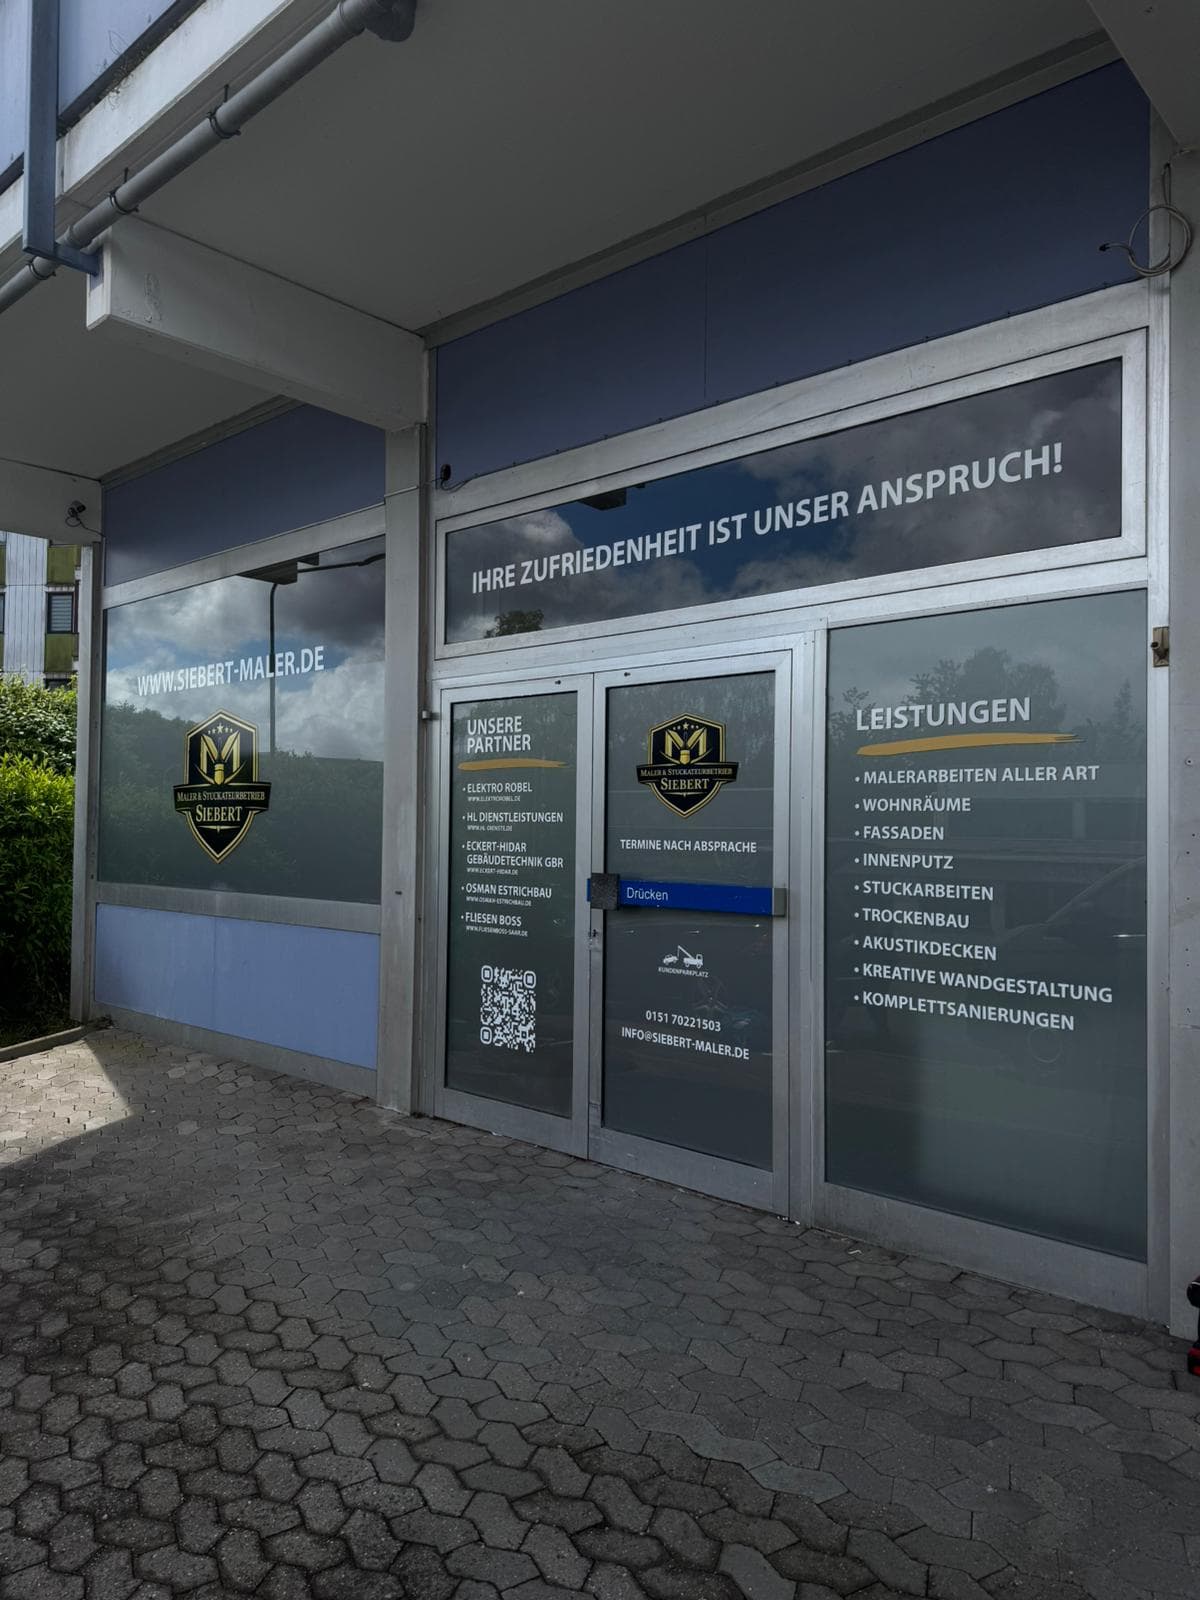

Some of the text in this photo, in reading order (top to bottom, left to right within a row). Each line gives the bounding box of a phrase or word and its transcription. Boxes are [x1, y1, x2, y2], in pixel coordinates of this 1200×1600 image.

[471, 442, 1064, 594] IHRE ZUFRIEDENHEIT IST UNSER ANSPRUCH!
[137, 645, 325, 697] WWW.SIEBERT-MALER.DE
[856, 697, 1032, 732] LEISTUNGEN
[467, 715, 523, 736] UNSERE
[467, 733, 532, 754] PARTNER
[863, 765, 1100, 785] MALERARBEITEN ALLER ART
[467, 782, 533, 794] ELEKTRO ROBEL
[862, 795, 972, 813] WOHNRÄUME
[466, 811, 564, 823] HL DIENSTLEISTUNGEN
[863, 825, 945, 841] FASSADEN
[466, 841, 527, 853] ECKERT-HIDAR
[620, 839, 757, 853] TERMINE NACH ABSPRACHE
[466, 853, 564, 868] GEBÄUDETECHNIK GBR
[863, 853, 954, 870] INNENPUTZ
[466, 883, 552, 899] OSMAN ESTRICHBAU
[626, 887, 669, 901] Drücken
[863, 880, 995, 901] STUCKARBEITEN
[465, 912, 522, 927] FLIESEN BOSS
[862, 908, 970, 928] TROCKENBAU
[862, 935, 997, 961] AKUSTIKDECKEN
[658, 966, 709, 978] KUNDENPARKPLATZ
[862, 963, 1113, 1003] KREATIVE WANDGESTALTUNG
[645, 1010, 721, 1032] 0151 70221503
[862, 991, 1075, 1031] KOMPLETTSANIERUNGEN
[621, 1026, 750, 1060] INFO@SIEBERT-MALER.DE
